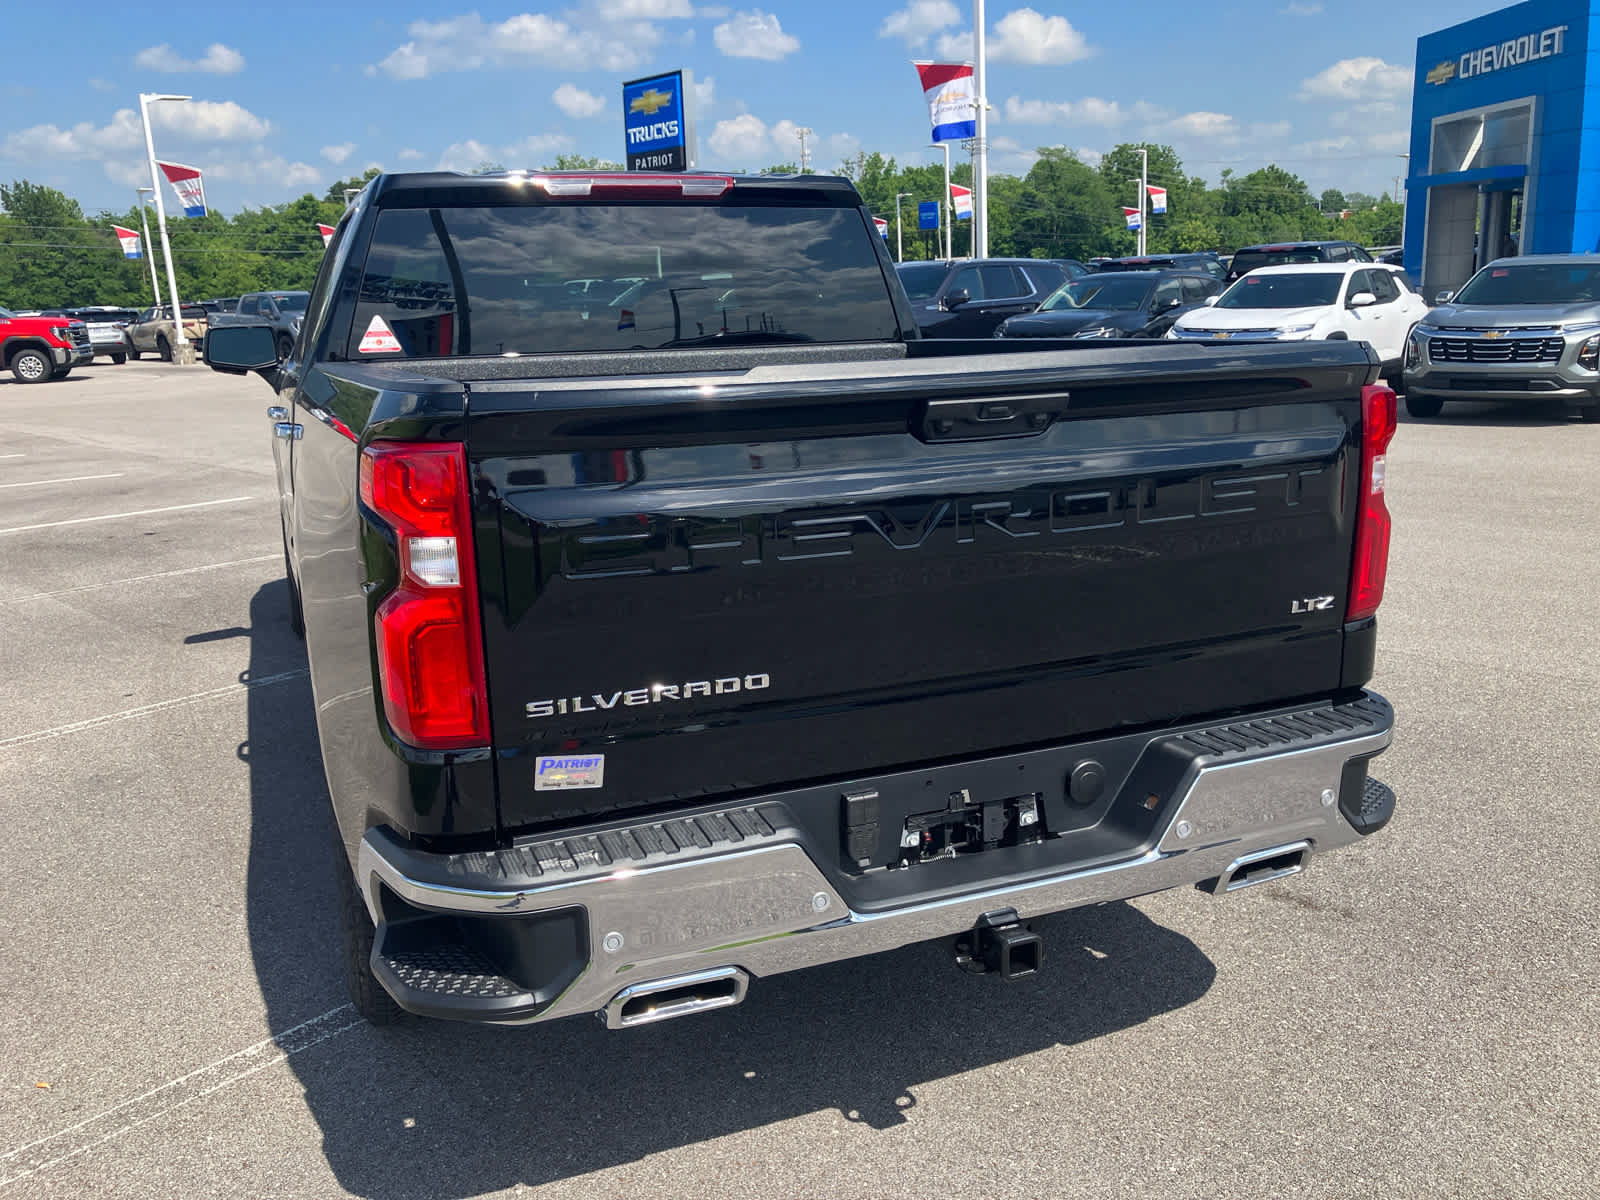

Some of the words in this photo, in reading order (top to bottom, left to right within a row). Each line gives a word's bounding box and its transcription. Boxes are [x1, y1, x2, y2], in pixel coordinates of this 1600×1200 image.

[1459, 25, 1569, 79] CHEVROLET
[627, 120, 679, 144] TRUCKS
[635, 153, 673, 170] PATRIOT
[560, 466, 1324, 580] CHEVROLET
[1291, 596, 1335, 614] LTZ
[525, 673, 770, 718] SILVERADO
[539, 758, 602, 775] PATRIOT
